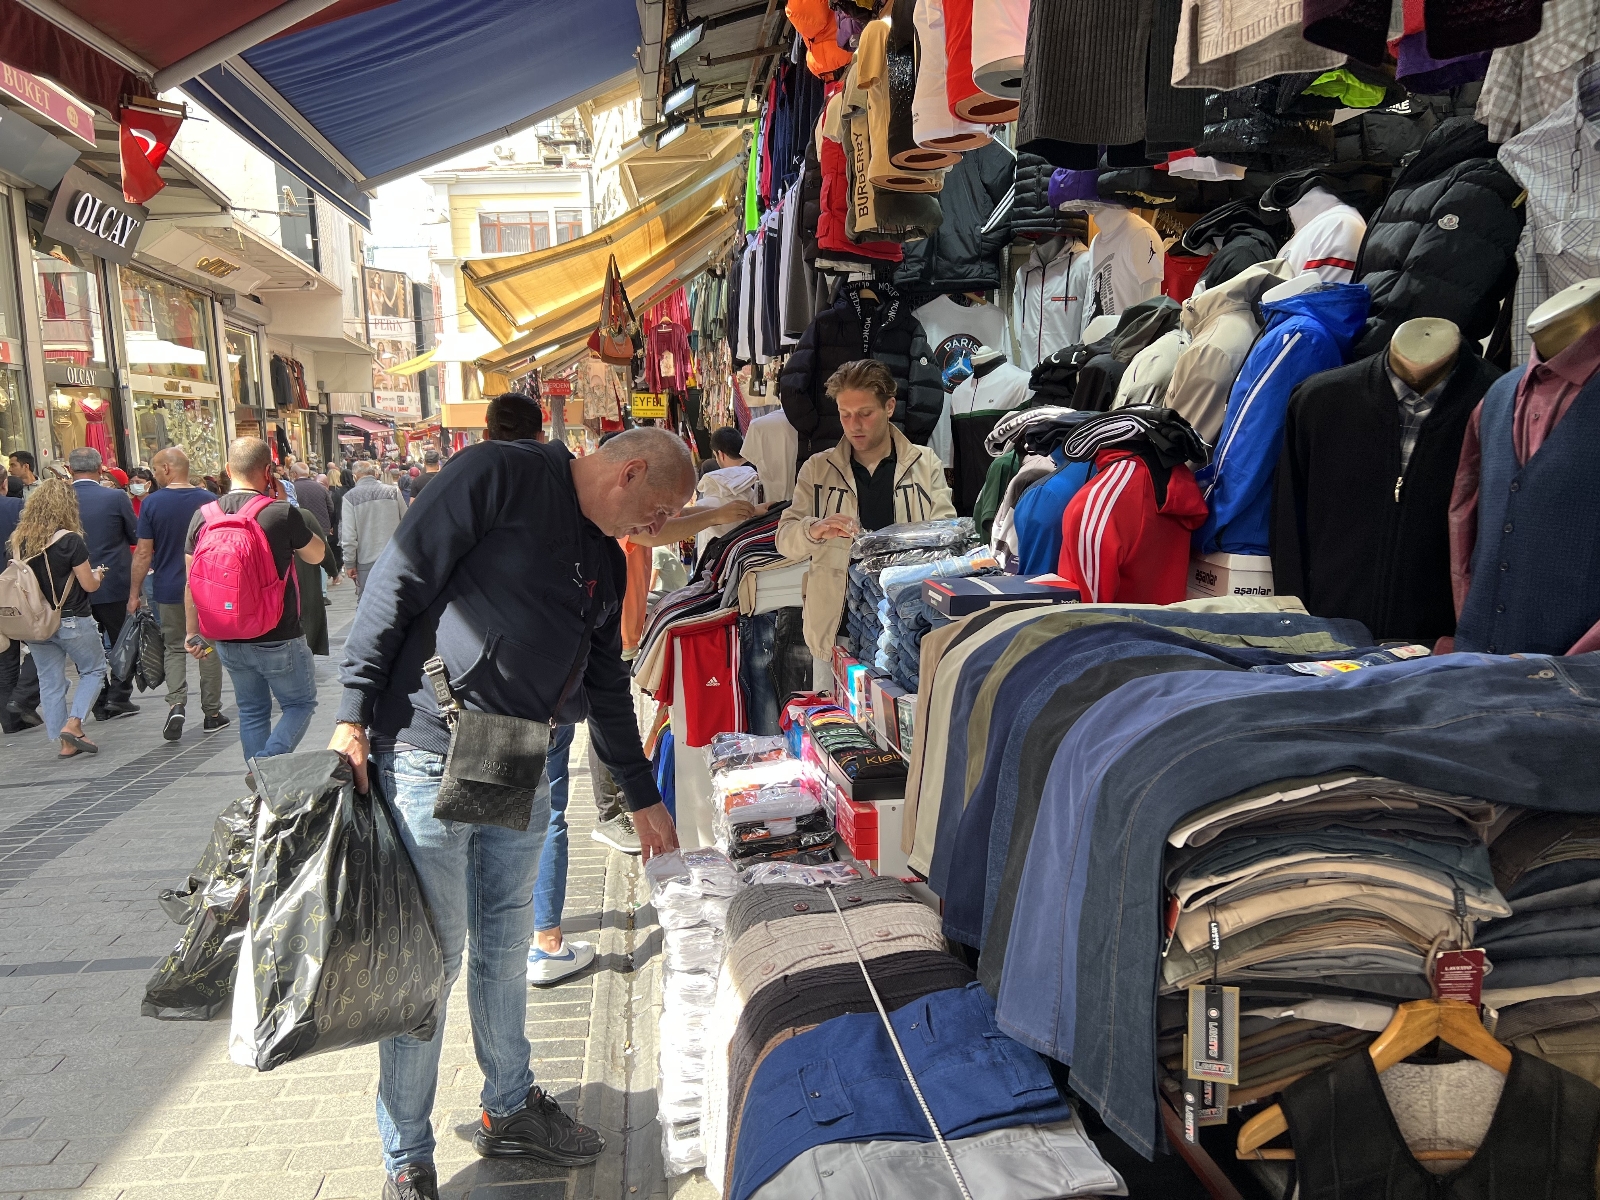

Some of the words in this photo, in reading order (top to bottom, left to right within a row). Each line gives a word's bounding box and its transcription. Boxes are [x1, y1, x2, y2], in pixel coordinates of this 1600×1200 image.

[3, 63, 50, 111] BUKET
[853, 132, 869, 218] BURBERRY
[73, 192, 138, 248] OLCAY
[944, 338, 979, 353] PARIS
[67, 366, 95, 386] OLCAY
[632, 396, 665, 407] EYFEL
[1195, 569, 1217, 586] aşanlar
[1234, 586, 1271, 596] aşanlar
[1208, 1021, 1219, 1059] LAVETTO
